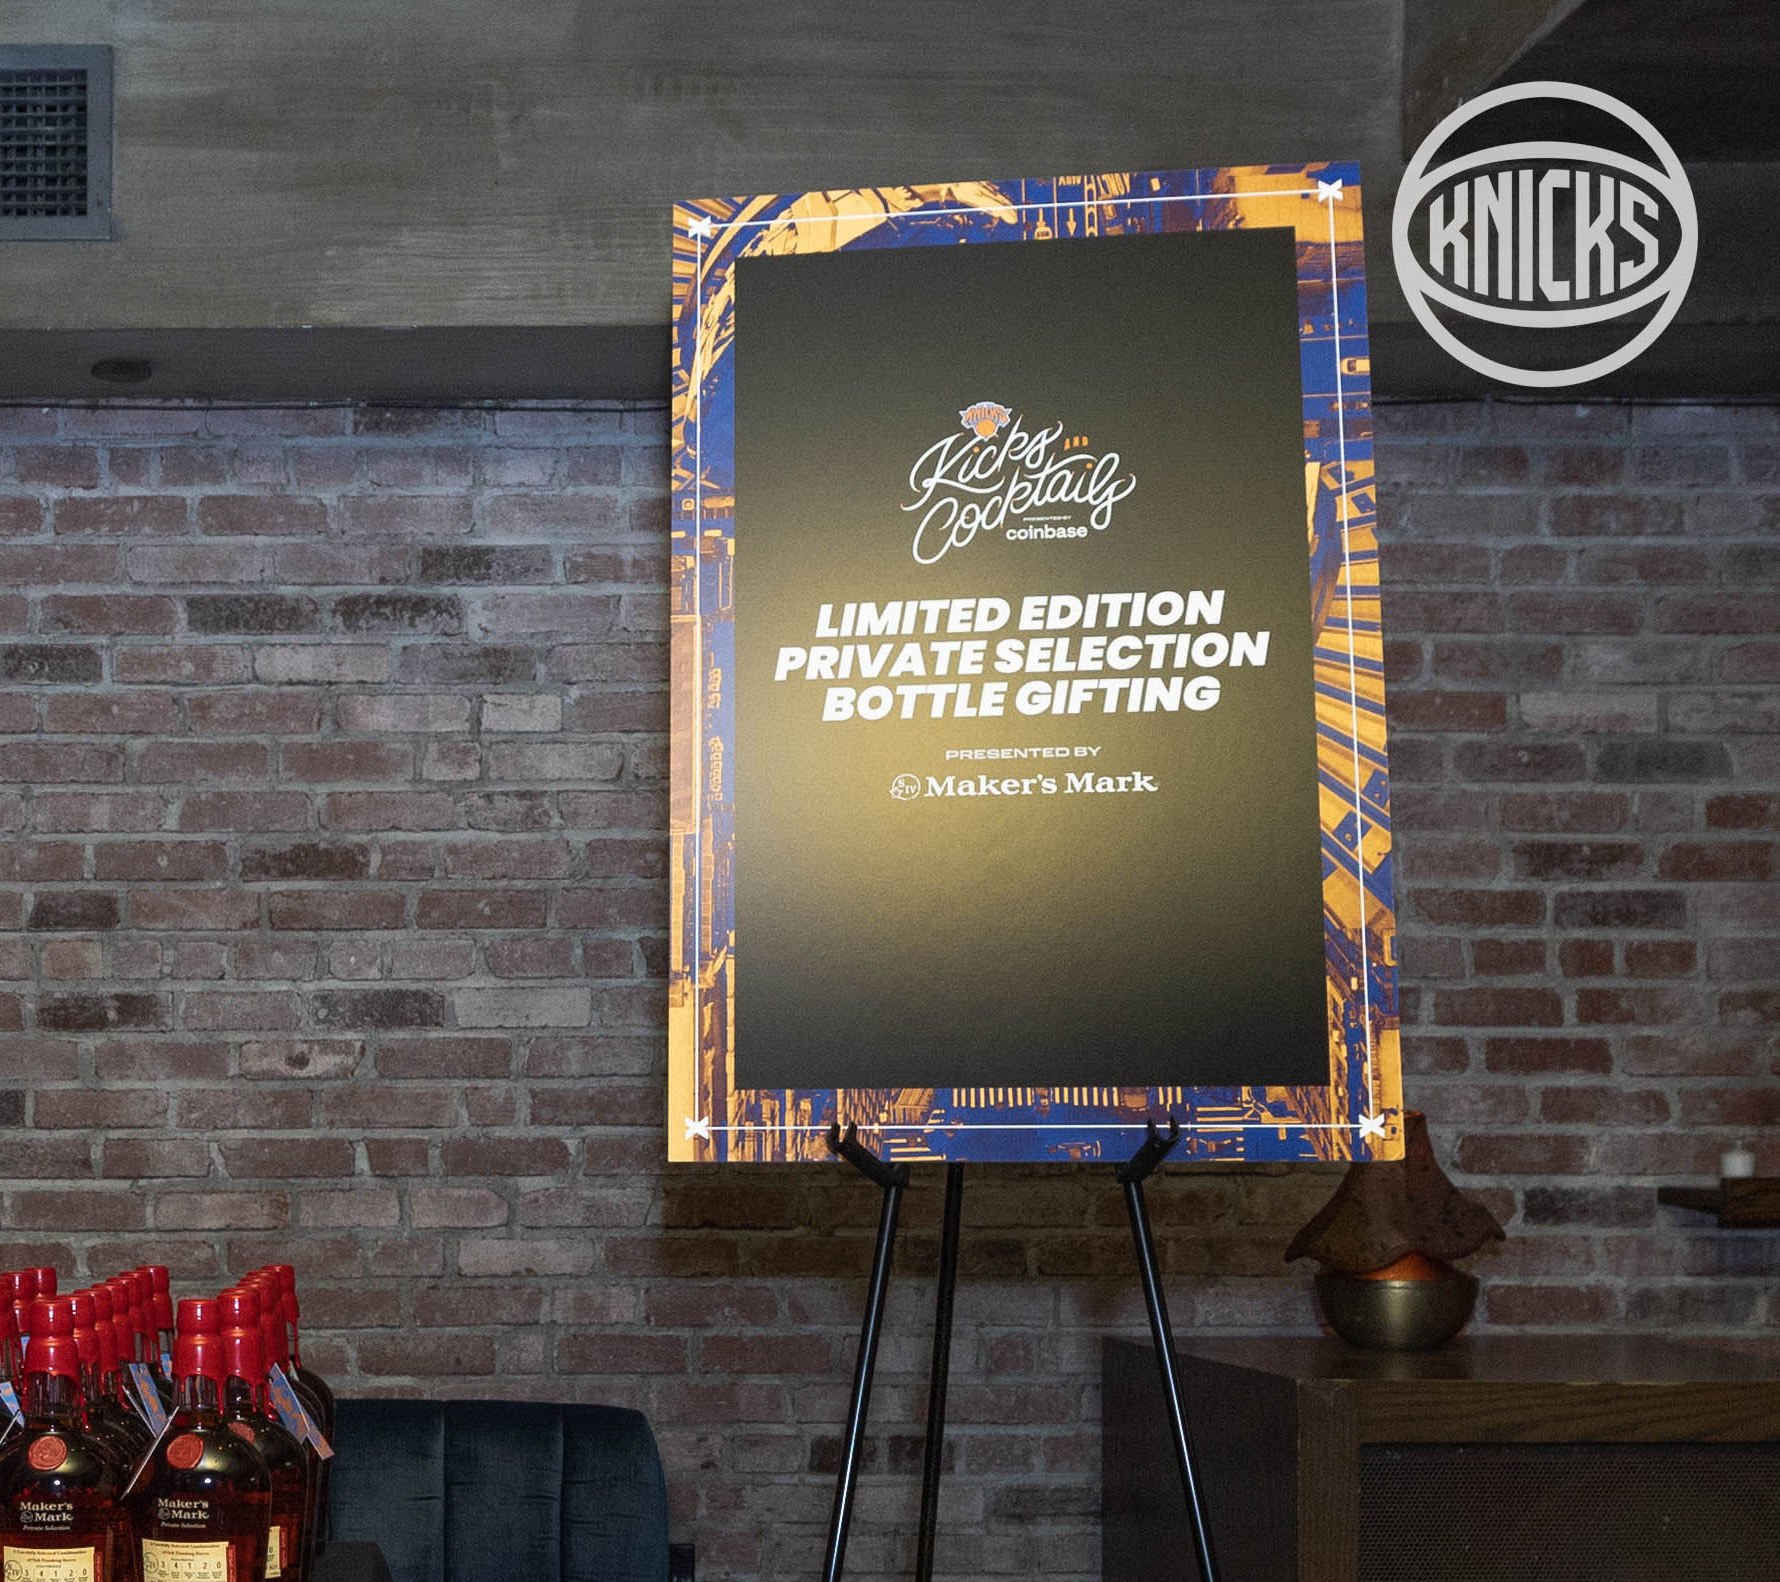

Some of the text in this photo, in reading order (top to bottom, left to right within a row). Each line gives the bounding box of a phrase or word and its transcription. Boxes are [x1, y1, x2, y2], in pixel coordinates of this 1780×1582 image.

[901, 414, 1063, 511] Kicks
[912, 452, 1137, 565] Cocktails
[1006, 524, 1088, 540] coinbase
[815, 589, 1225, 638] LIMITED EDITION
[774, 631, 1270, 681] PRIVATE SELECTION
[822, 675, 1221, 721] BOTTLE GIFTING
[945, 746, 1101, 760] PRESENTED BY
[924, 771, 1157, 797] Maker's Mark
[20, 1502, 73, 1510] Maker's
[158, 1499, 208, 1508] Maker's
[34, 1513, 71, 1521] Mark
[172, 1510, 207, 1519] Mark
